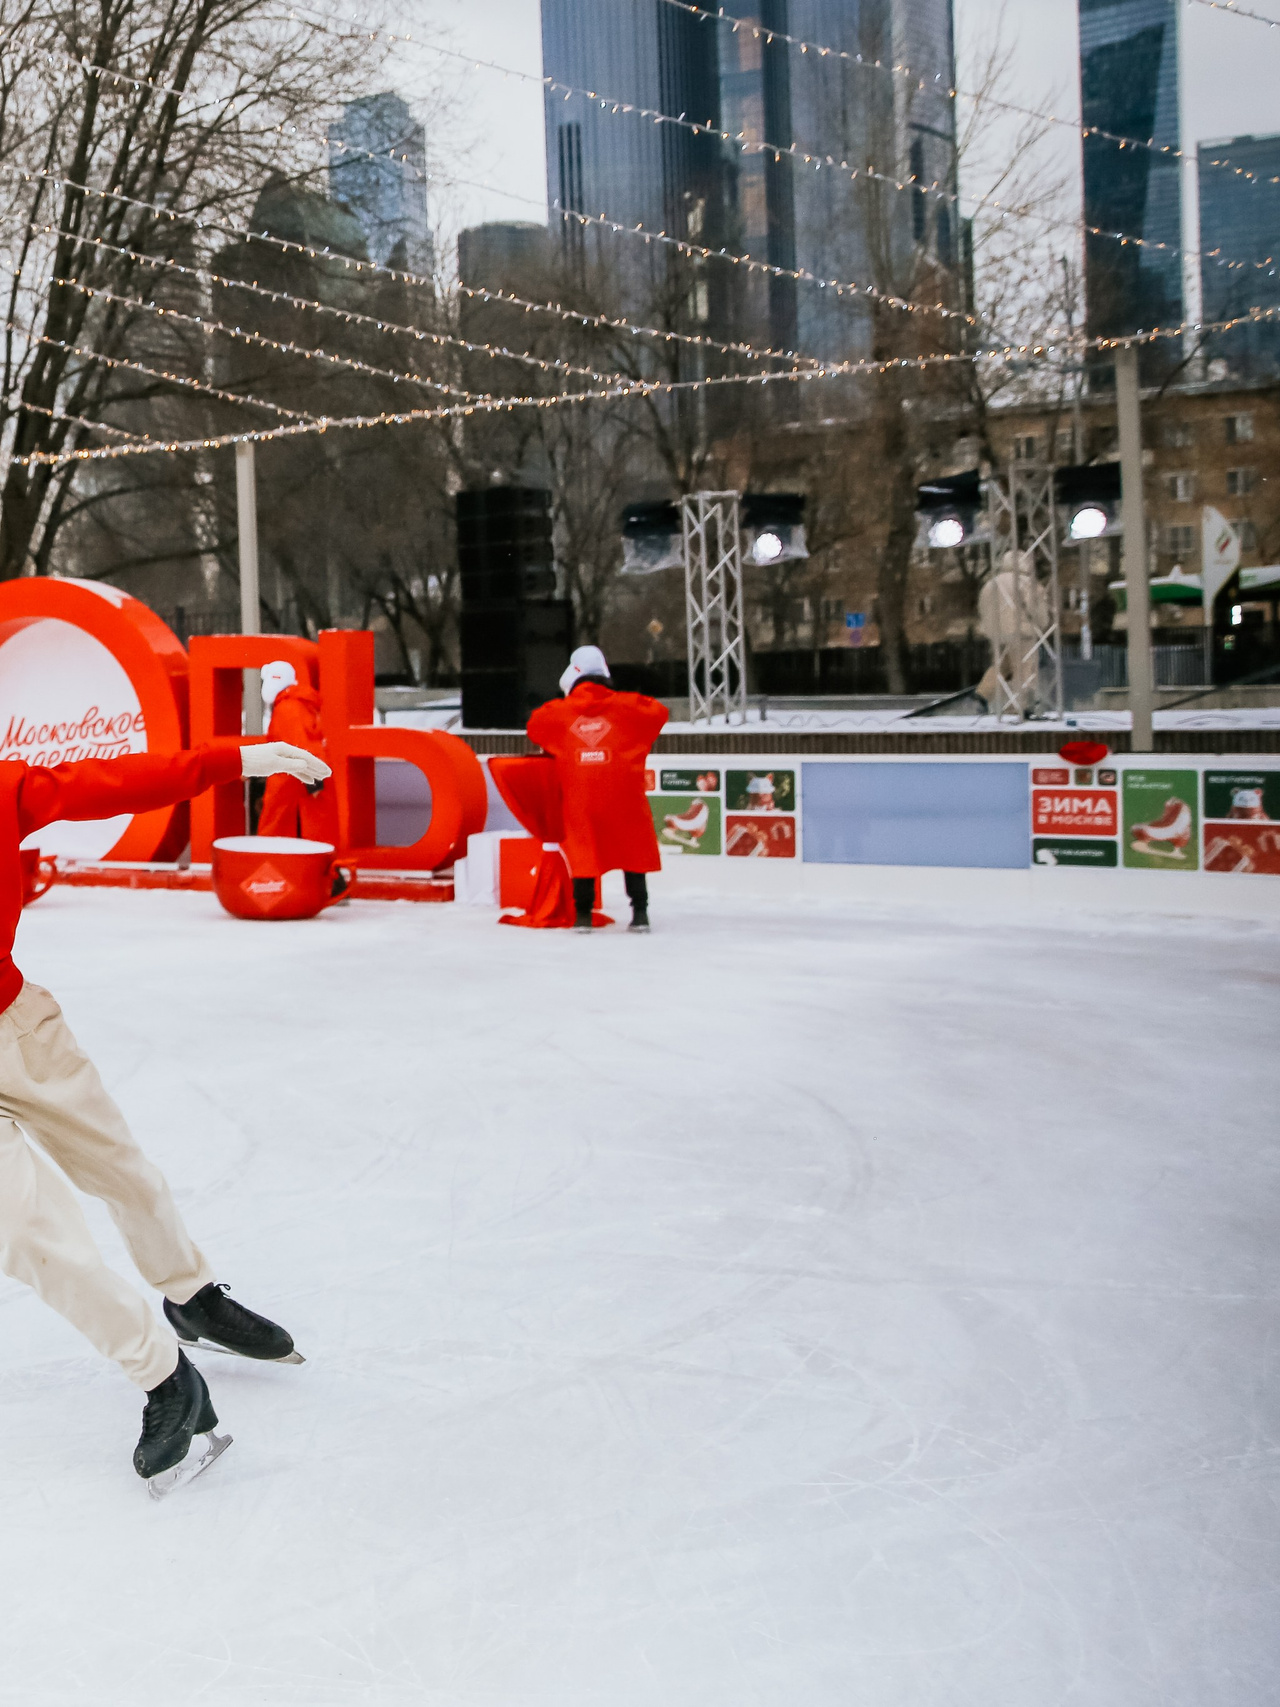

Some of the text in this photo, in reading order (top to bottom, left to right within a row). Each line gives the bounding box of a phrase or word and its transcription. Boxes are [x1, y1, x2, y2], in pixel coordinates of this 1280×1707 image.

[1037, 797, 1113, 814] ЗИМА
[1037, 814, 1113, 826] В МОСКВЕ
